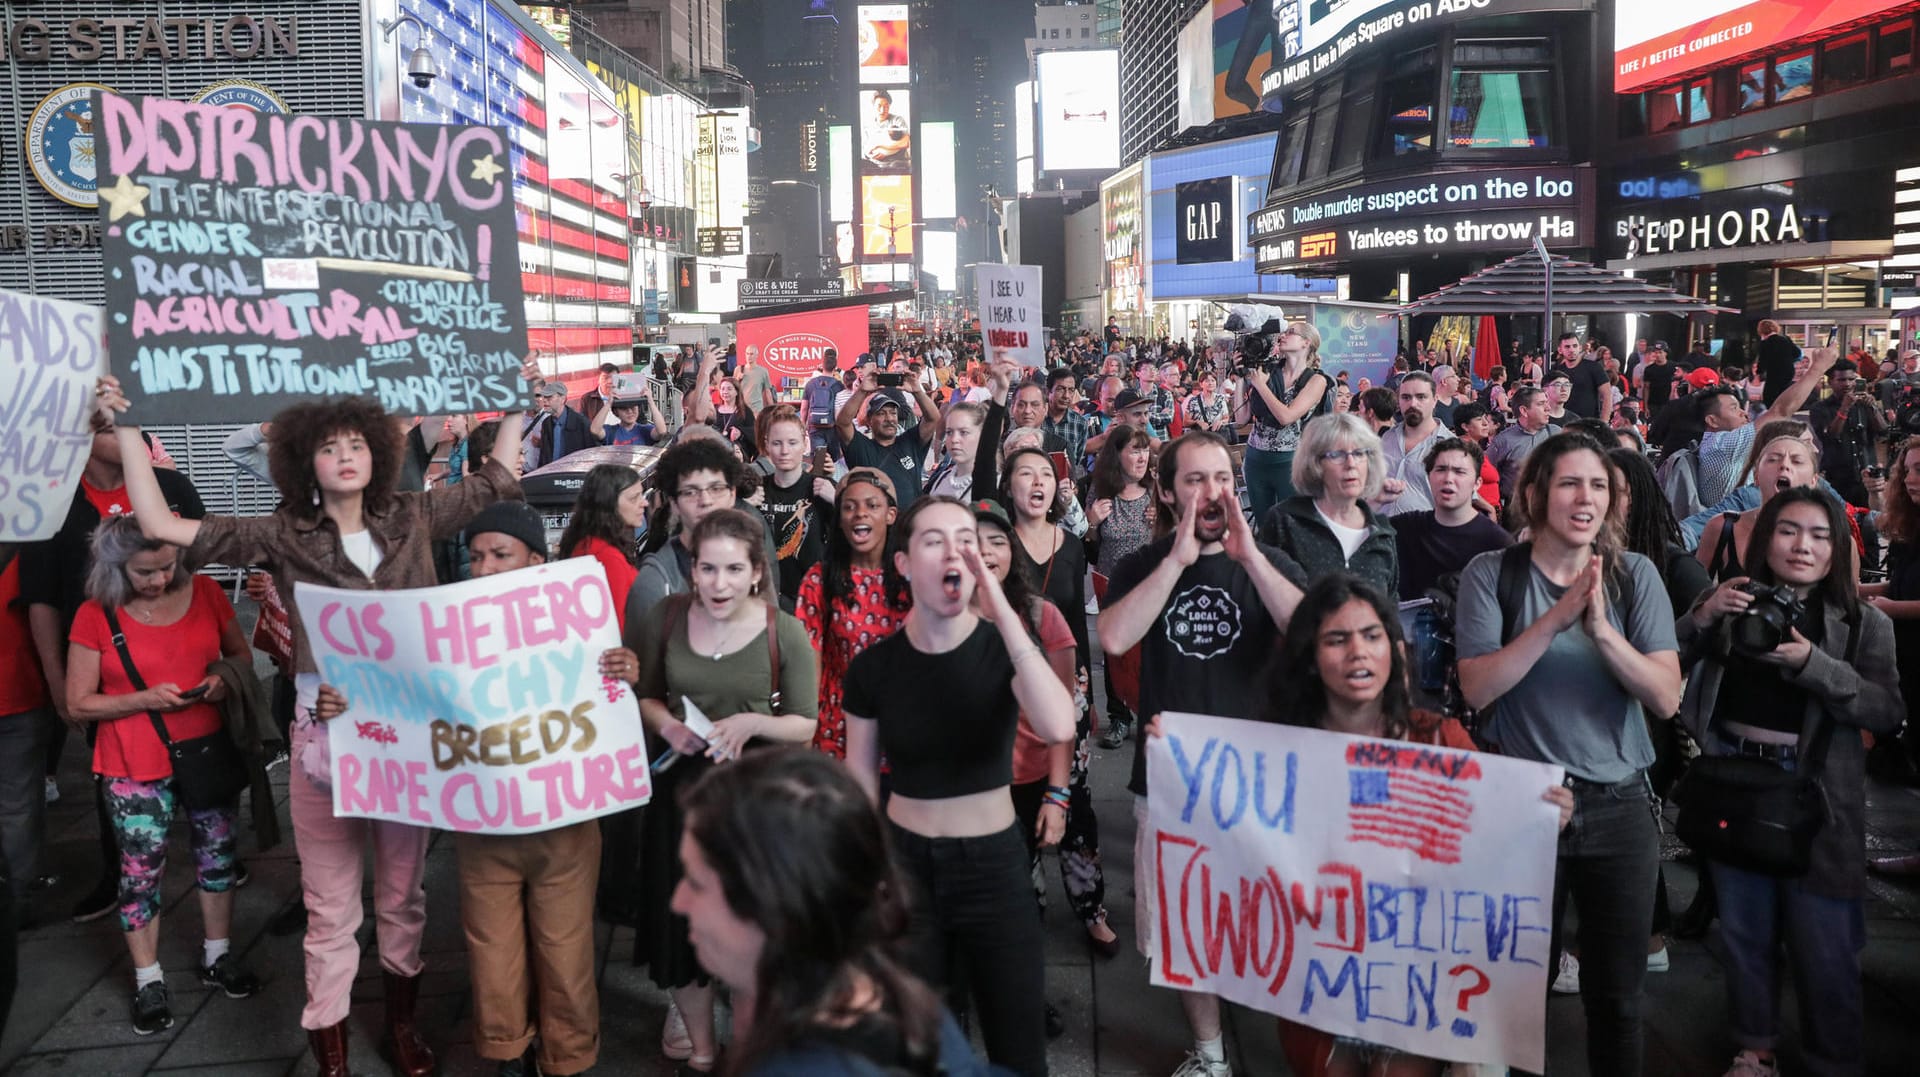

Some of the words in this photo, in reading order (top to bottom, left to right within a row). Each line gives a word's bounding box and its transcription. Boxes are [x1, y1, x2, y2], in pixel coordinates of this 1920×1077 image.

[67, 15, 299, 60] STATION
[1284, 59, 1310, 84] MUIR
[1313, 52, 1329, 72] Live
[1329, 45, 1337, 64] in
[1358, 11, 1404, 43] Square
[1408, 2, 1431, 23] on
[1620, 59, 1639, 75] LIFE
[1650, 45, 1686, 65] BETTER
[1689, 22, 1753, 52] CONNECTED
[250, 93, 265, 107] THE
[31, 95, 63, 164] DEPARTMENT
[70, 88, 87, 99] OF
[720, 134, 737, 143] LION
[808, 120, 817, 172] NOVOTEL
[719, 144, 740, 155] KING
[137, 175, 211, 218] THE
[1293, 202, 1322, 224] Double
[1324, 195, 1364, 218] murder
[1367, 183, 1438, 211] suspect
[1444, 183, 1477, 202] on
[1485, 177, 1528, 199] the
[1536, 176, 1573, 198] loo
[126, 219, 263, 257] GENDER
[1186, 202, 1221, 241] GAP
[1300, 232, 1336, 258] ESPN
[1348, 227, 1418, 250] Yankees
[1424, 224, 1448, 244] to
[1455, 220, 1533, 242] throw
[1540, 216, 1574, 239] Ha
[1628, 204, 1800, 260] SEPHORA
[1281, 240, 1295, 259] WR
[131, 255, 263, 297] RACIAL
[383, 280, 503, 308] CRIMINAL
[755, 281, 769, 289] ICE
[779, 281, 798, 289] VICE
[827, 280, 840, 288] 5%
[990, 280, 993, 298] I
[997, 281, 1012, 297] SEE
[1015, 281, 1024, 297] U
[132, 287, 418, 344] AGRICULTURAL
[408, 303, 512, 333] JUSTICE
[988, 306, 991, 323] I
[994, 307, 1016, 323] HEAR
[1018, 308, 1026, 323] U
[417, 332, 467, 359] BIG
[429, 350, 524, 378] PHARMA
[319, 602, 396, 661] CIS
[419, 575, 611, 669] HETERO
[1188, 612, 1219, 621] LOCAL
[430, 701, 597, 771] BREEDS
[338, 754, 433, 824] RAPE
[440, 744, 650, 831] CULTURE
[1166, 734, 1298, 834] YOU
[1366, 881, 1550, 969] BELIEVE
